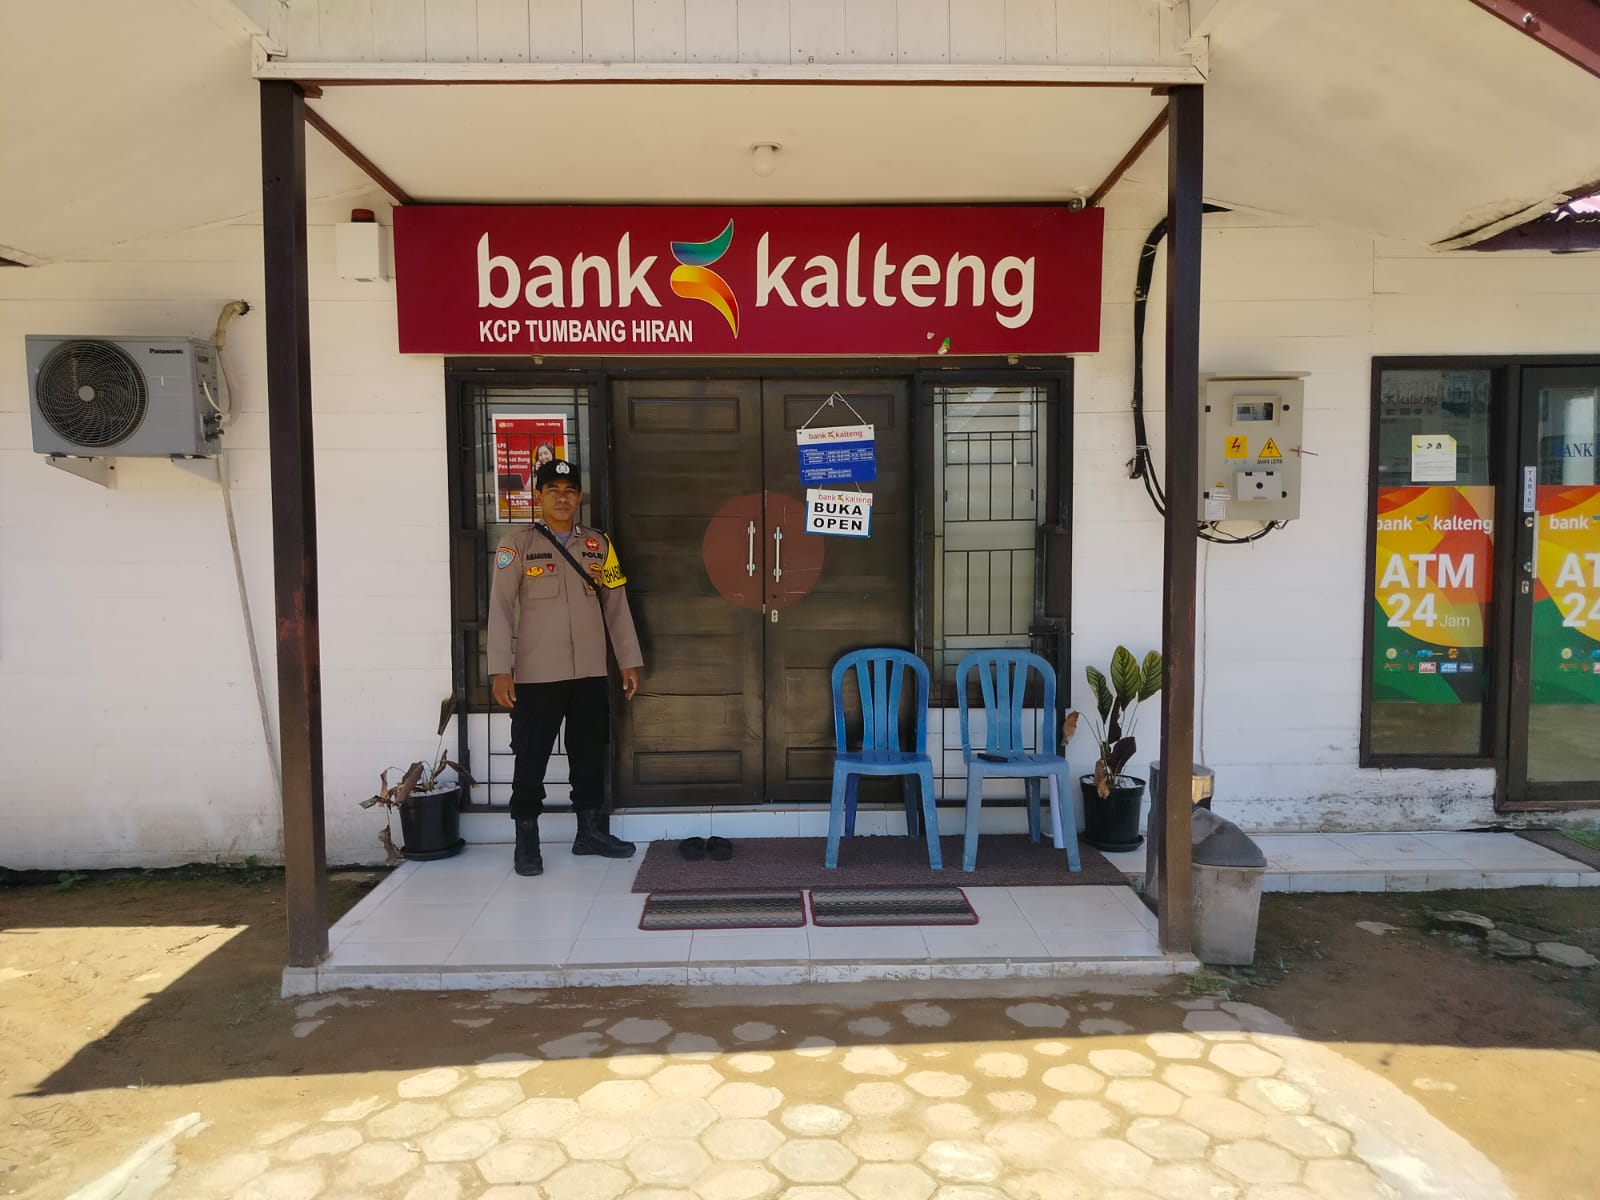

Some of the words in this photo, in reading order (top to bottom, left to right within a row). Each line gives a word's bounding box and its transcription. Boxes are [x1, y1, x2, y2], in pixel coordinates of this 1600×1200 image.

[477, 231, 660, 309] bank
[755, 231, 1036, 330] kalteng
[479, 320, 522, 344] KCP
[525, 319, 628, 344] TUMBANG
[631, 318, 694, 343] HIRAN
[808, 431, 827, 440] bank
[835, 429, 863, 440] kalteng
[818, 492, 836, 502] bank
[845, 494, 873, 505] kalteng
[814, 502, 863, 516] BUKA
[813, 517, 862, 531] OPEN
[1433, 514, 1494, 534] kalteng
[1549, 514, 1589, 530] bank
[1379, 553, 1475, 589] ATM
[1387, 592, 1437, 628] 24
[1439, 615, 1470, 628] Jam
